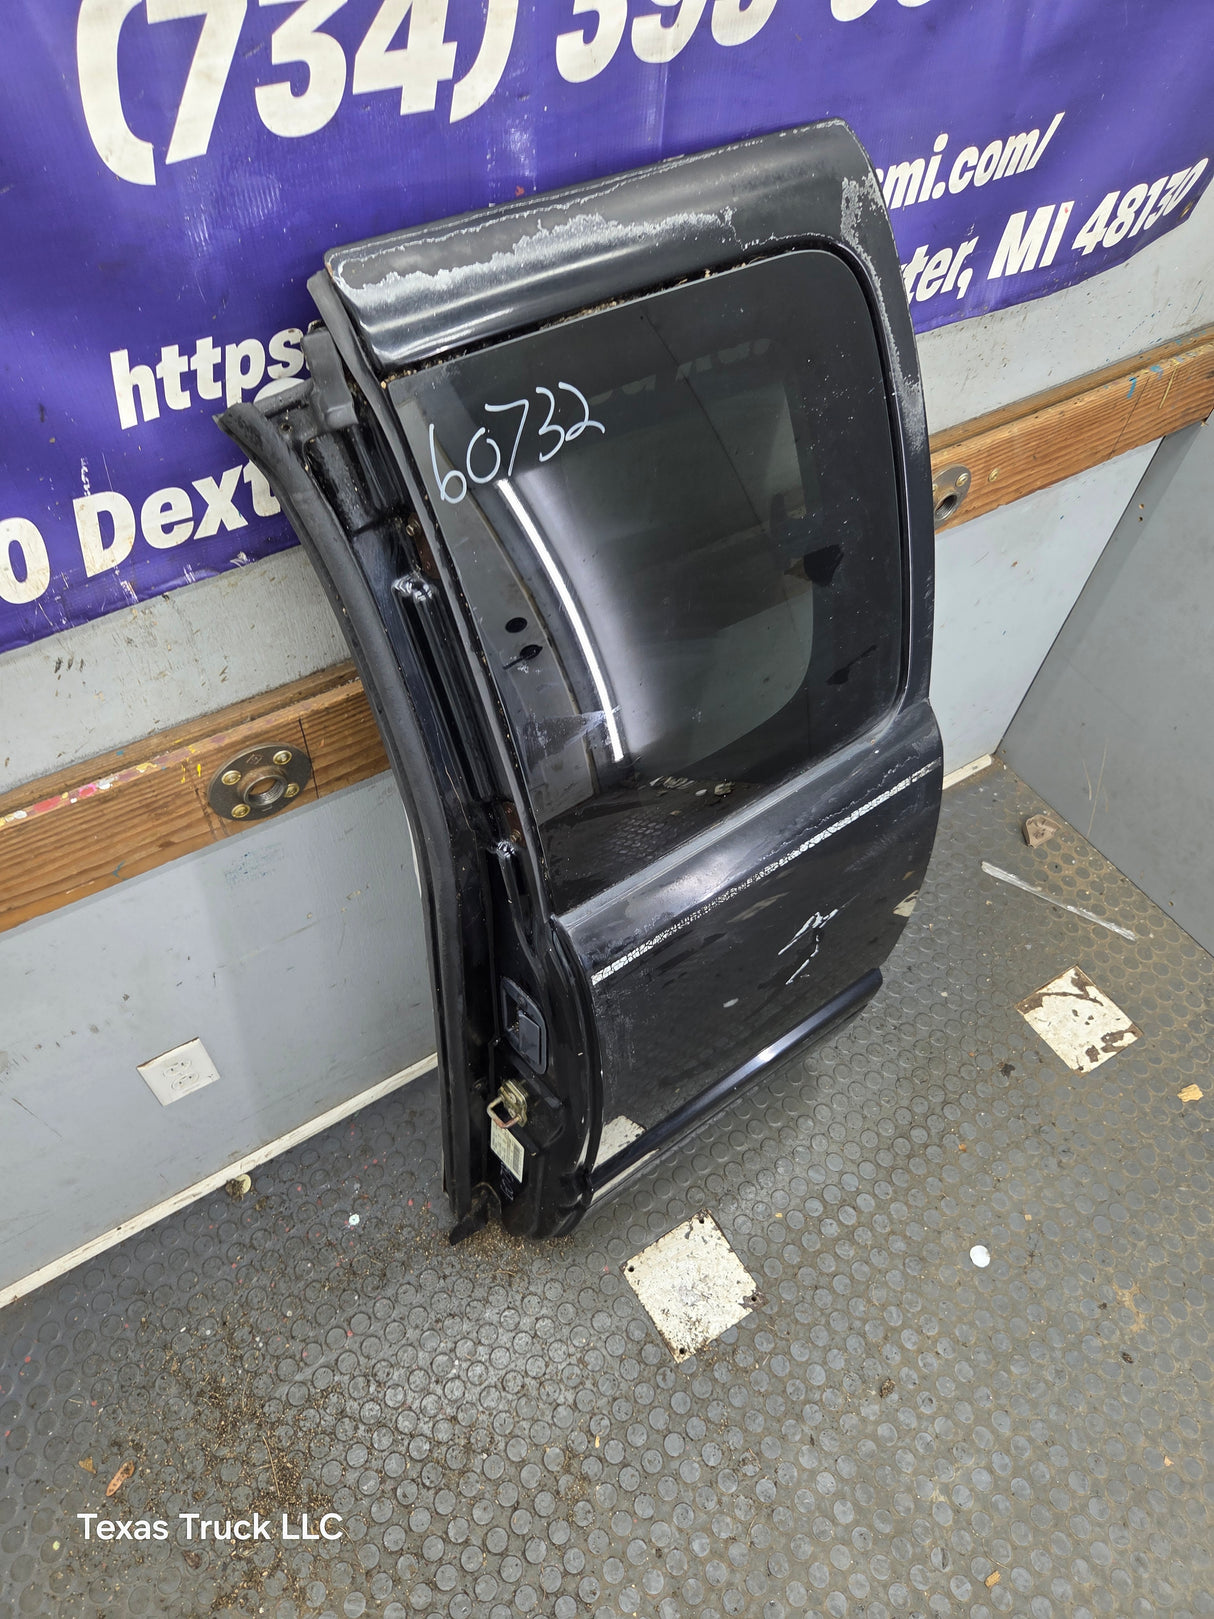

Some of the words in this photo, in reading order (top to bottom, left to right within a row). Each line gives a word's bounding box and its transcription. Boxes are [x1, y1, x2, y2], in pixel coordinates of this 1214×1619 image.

[72, 459, 282, 578] Dext
[901, 236, 979, 304] ter,
[987, 201, 1075, 280] MI
[1071, 157, 1209, 256] 48130
[109, 319, 318, 430] https
[875, 111, 1066, 210] mi.com/
[429, 381, 606, 504] 60732
